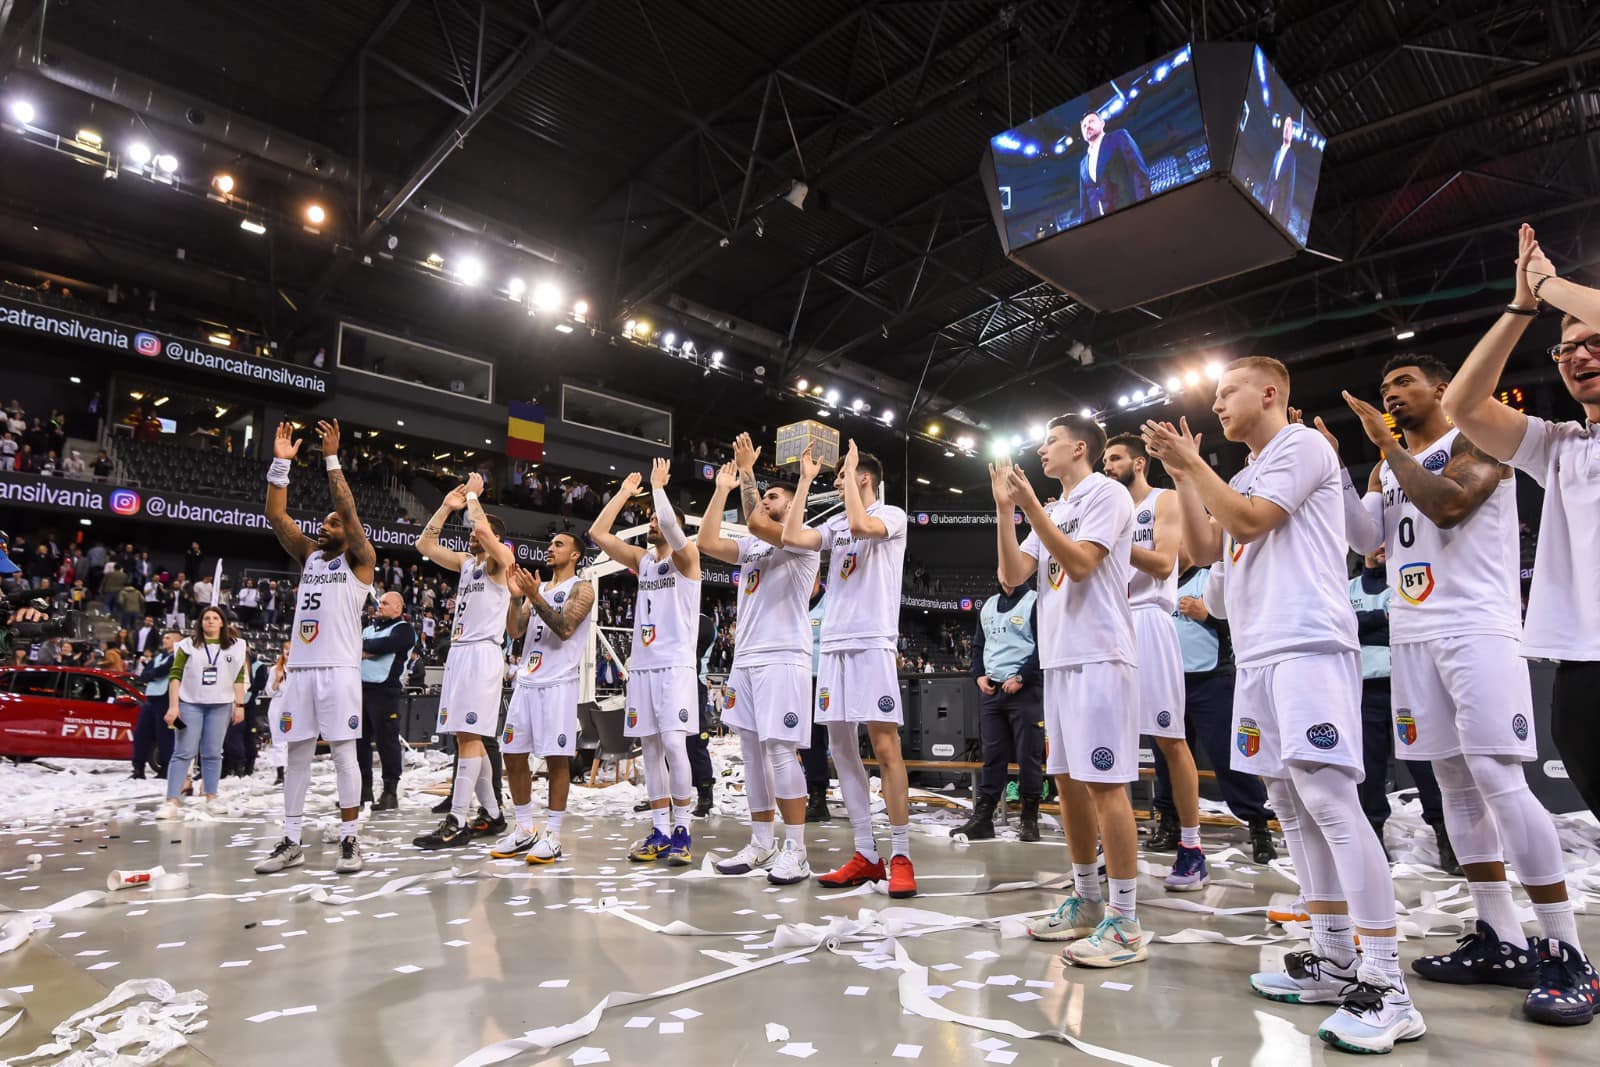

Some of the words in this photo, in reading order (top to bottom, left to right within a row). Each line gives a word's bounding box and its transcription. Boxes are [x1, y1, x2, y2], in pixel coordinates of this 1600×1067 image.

[166, 342, 326, 393] @ubancatransilvania
[1398, 517, 1415, 548] 0
[1404, 571, 1425, 588] BT
[301, 592, 322, 610] 35
[302, 625, 315, 634] BT
[534, 625, 544, 642] 3
[61, 724, 135, 742] FABIA
